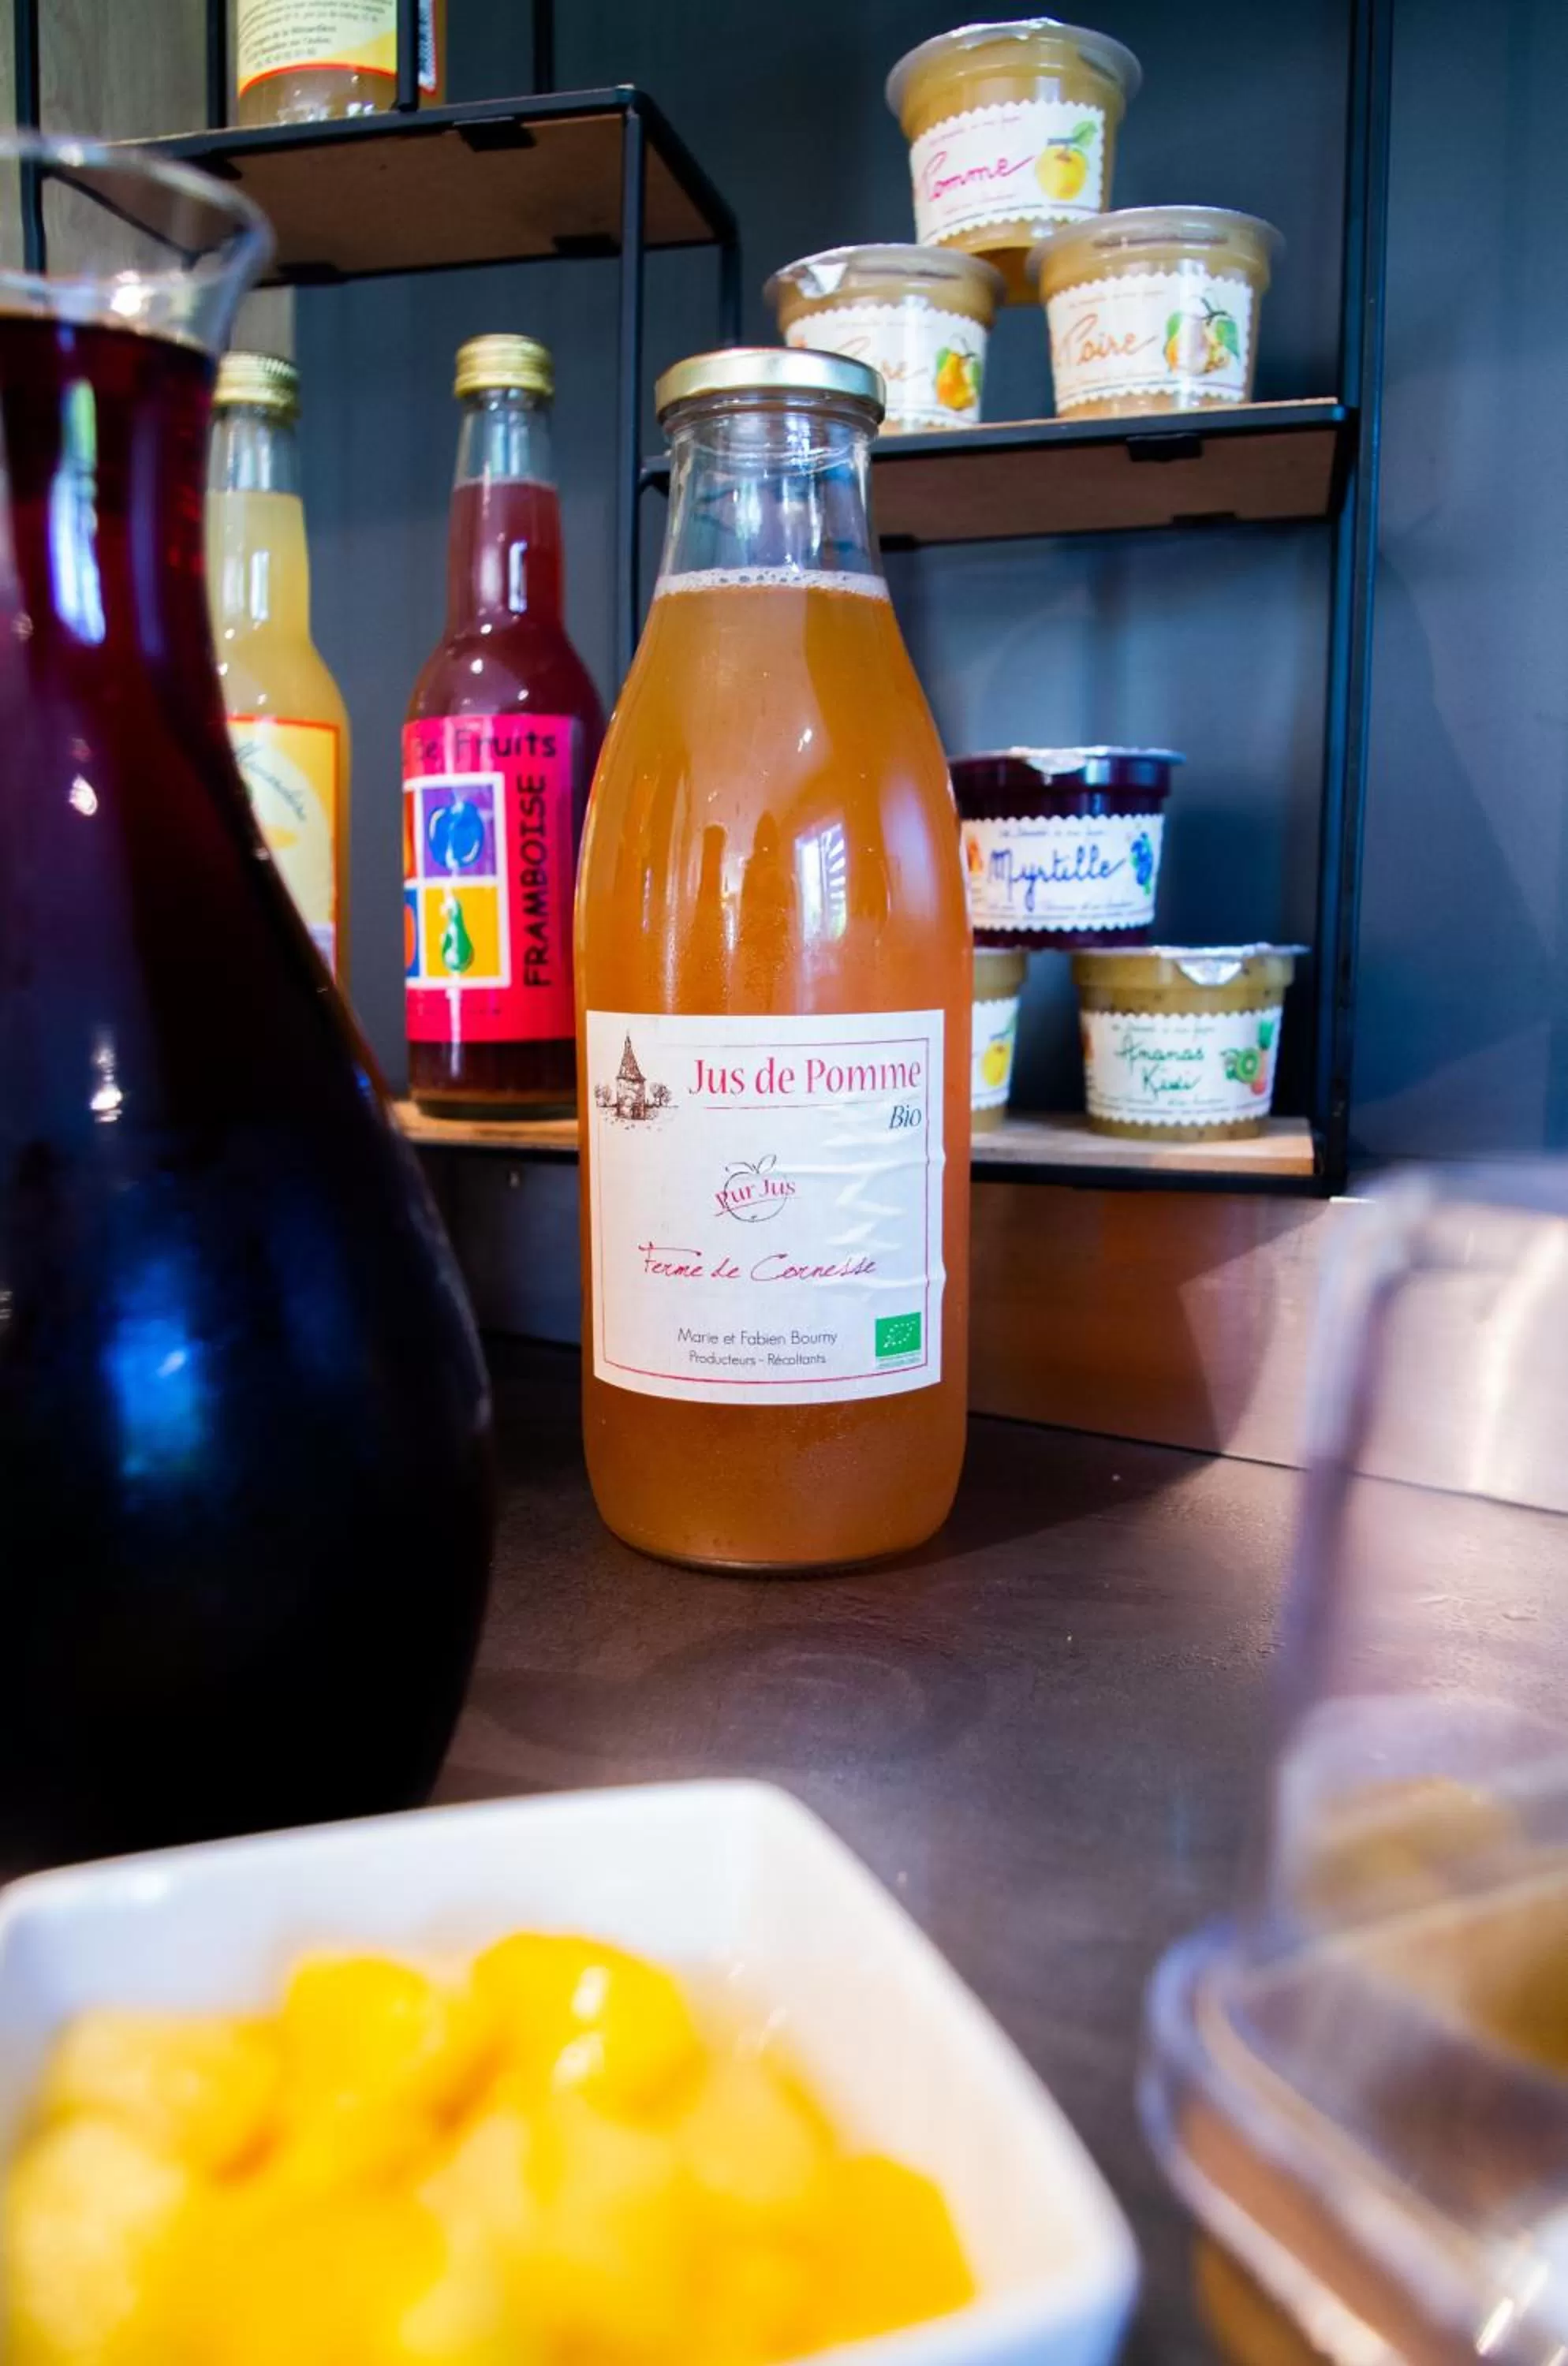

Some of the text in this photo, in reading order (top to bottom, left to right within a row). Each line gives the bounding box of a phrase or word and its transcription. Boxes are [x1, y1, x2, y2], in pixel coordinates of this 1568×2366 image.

[921, 151, 1035, 202] Pomme
[1058, 312, 1159, 367] Poire
[455, 728, 557, 762] Fruits
[517, 773, 551, 987] FRAMBOISE
[987, 843, 1126, 912] Myrtille
[689, 1056, 921, 1095] Jus de Pomme
[888, 1104, 922, 1129] Bio
[715, 1179, 797, 1209] Pur Jus
[638, 1241, 878, 1281] Ferme de Cornesse
[678, 1327, 719, 1345] Marie
[723, 1334, 736, 1345] et
[740, 1330, 786, 1345] Fabien
[689, 1349, 756, 1366] Producteurs
[767, 1353, 827, 1366] Récoltants
